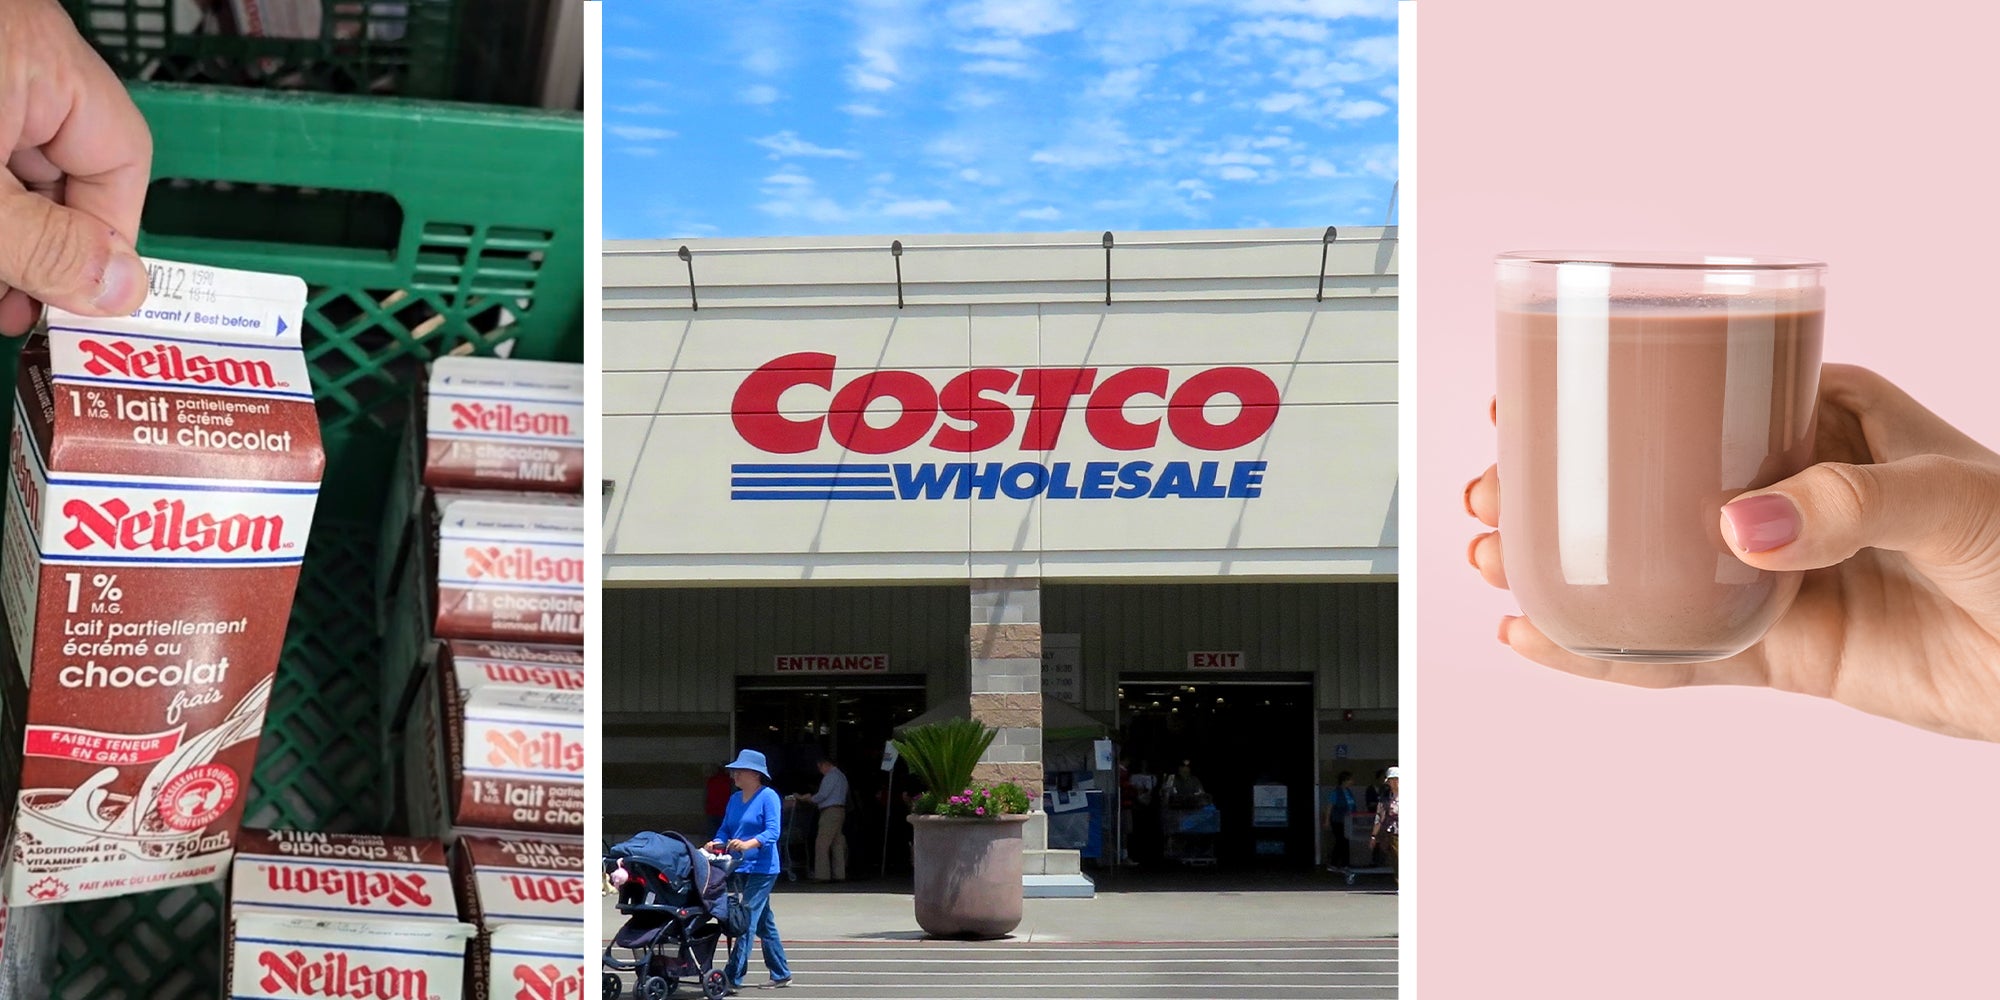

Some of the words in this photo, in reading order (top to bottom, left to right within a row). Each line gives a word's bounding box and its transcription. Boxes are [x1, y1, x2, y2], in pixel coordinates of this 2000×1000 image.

[145, 308, 182, 322] avant
[193, 312, 219, 326] Best
[221, 314, 261, 329] before
[78, 339, 277, 389] Neilson
[116, 394, 170, 423] lait
[175, 399, 270, 415] partiellement
[730, 351, 1280, 455] COSTCO
[177, 412, 235, 426] écrémé
[451, 402, 569, 436] Neilson
[133, 426, 169, 445] au
[176, 425, 291, 452] chocolat
[475, 444, 559, 461] chocolate
[518, 461, 568, 482] MILK
[891, 460, 1268, 500] WHOLESALE
[63, 497, 284, 553] Neilson
[91, 602, 124, 614] M.G.
[64, 619, 104, 636] Lait
[108, 617, 248, 639] partiellement
[63, 638, 149, 656] écrémé
[154, 642, 181, 656] au
[776, 656, 886, 671] ENTRANCE
[1193, 653, 1240, 667] EXIT
[59, 657, 229, 688] chocolat
[166, 687, 223, 725] frais
[51, 732, 103, 748] FAIBLE
[106, 738, 160, 751] TENEUR
[71, 747, 92, 759] EN
[95, 751, 138, 763] GRAS
[504, 783, 546, 806] lait
[512, 807, 541, 823] au
[268, 829, 328, 843] MILK
[27, 843, 100, 856] ADDITIONNÉ
[104, 843, 119, 851] DE
[165, 840, 198, 856] 750
[279, 840, 388, 860] chocolate
[498, 840, 561, 856] MILK
[27, 856, 88, 866] VITAMINES
[104, 855, 117, 863] ET
[79, 881, 101, 892] FAIT
[102, 878, 126, 889] AVEC
[129, 876, 144, 886] DU
[147, 873, 167, 883] LAIT
[169, 865, 217, 881] CANADIEN
[267, 864, 433, 907] Neilson
[258, 950, 428, 1000] Neilson
